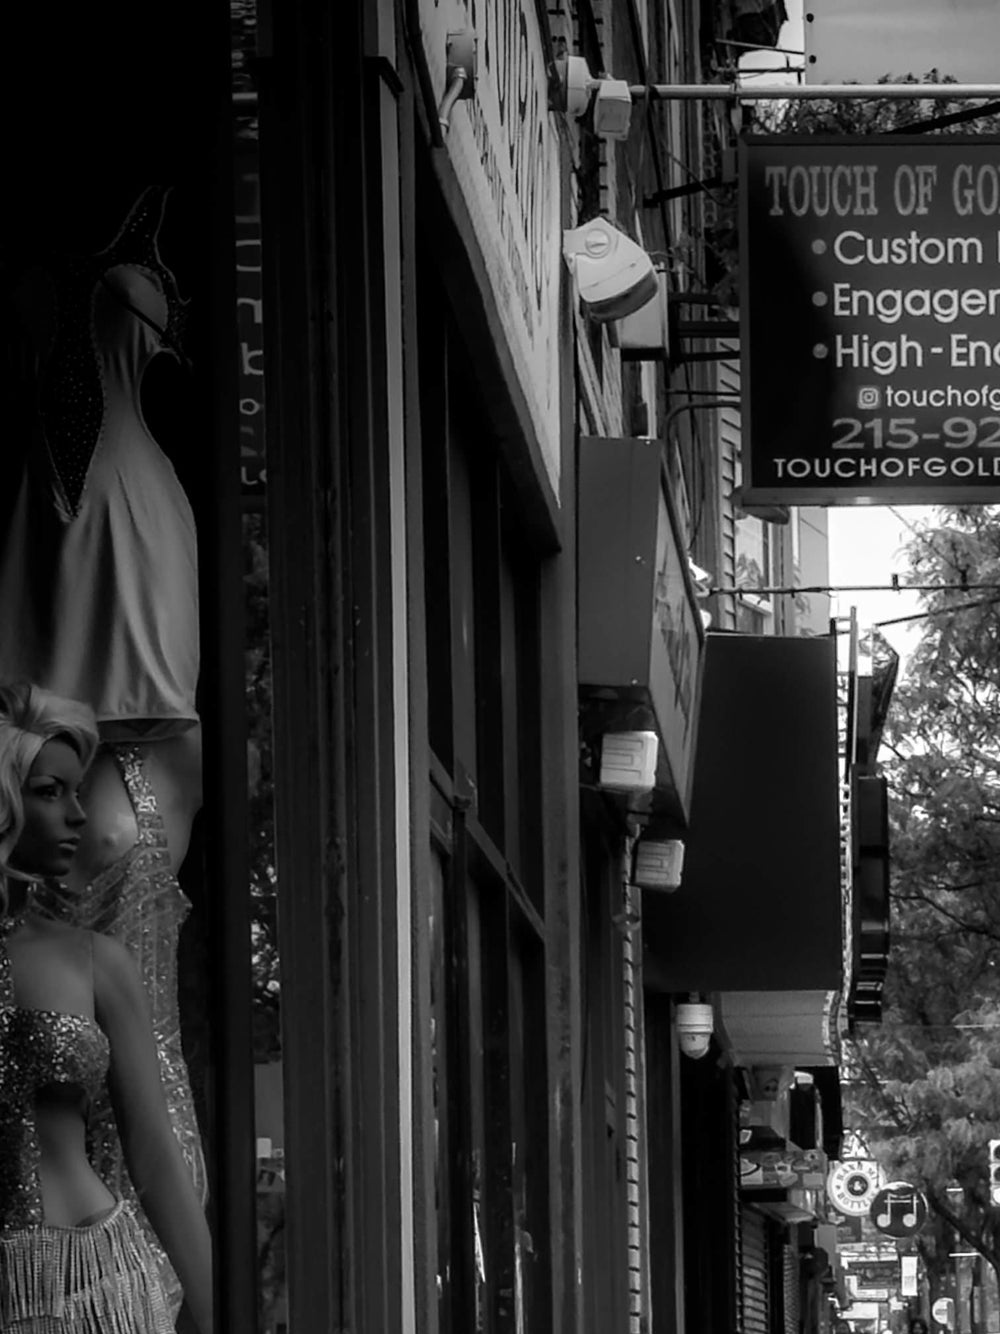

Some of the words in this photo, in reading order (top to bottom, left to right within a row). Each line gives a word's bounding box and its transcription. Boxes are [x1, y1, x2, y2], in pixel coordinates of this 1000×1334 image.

[766, 164, 877, 216] TOUCH
[894, 164, 937, 216] OF
[833, 230, 982, 265] Custom
